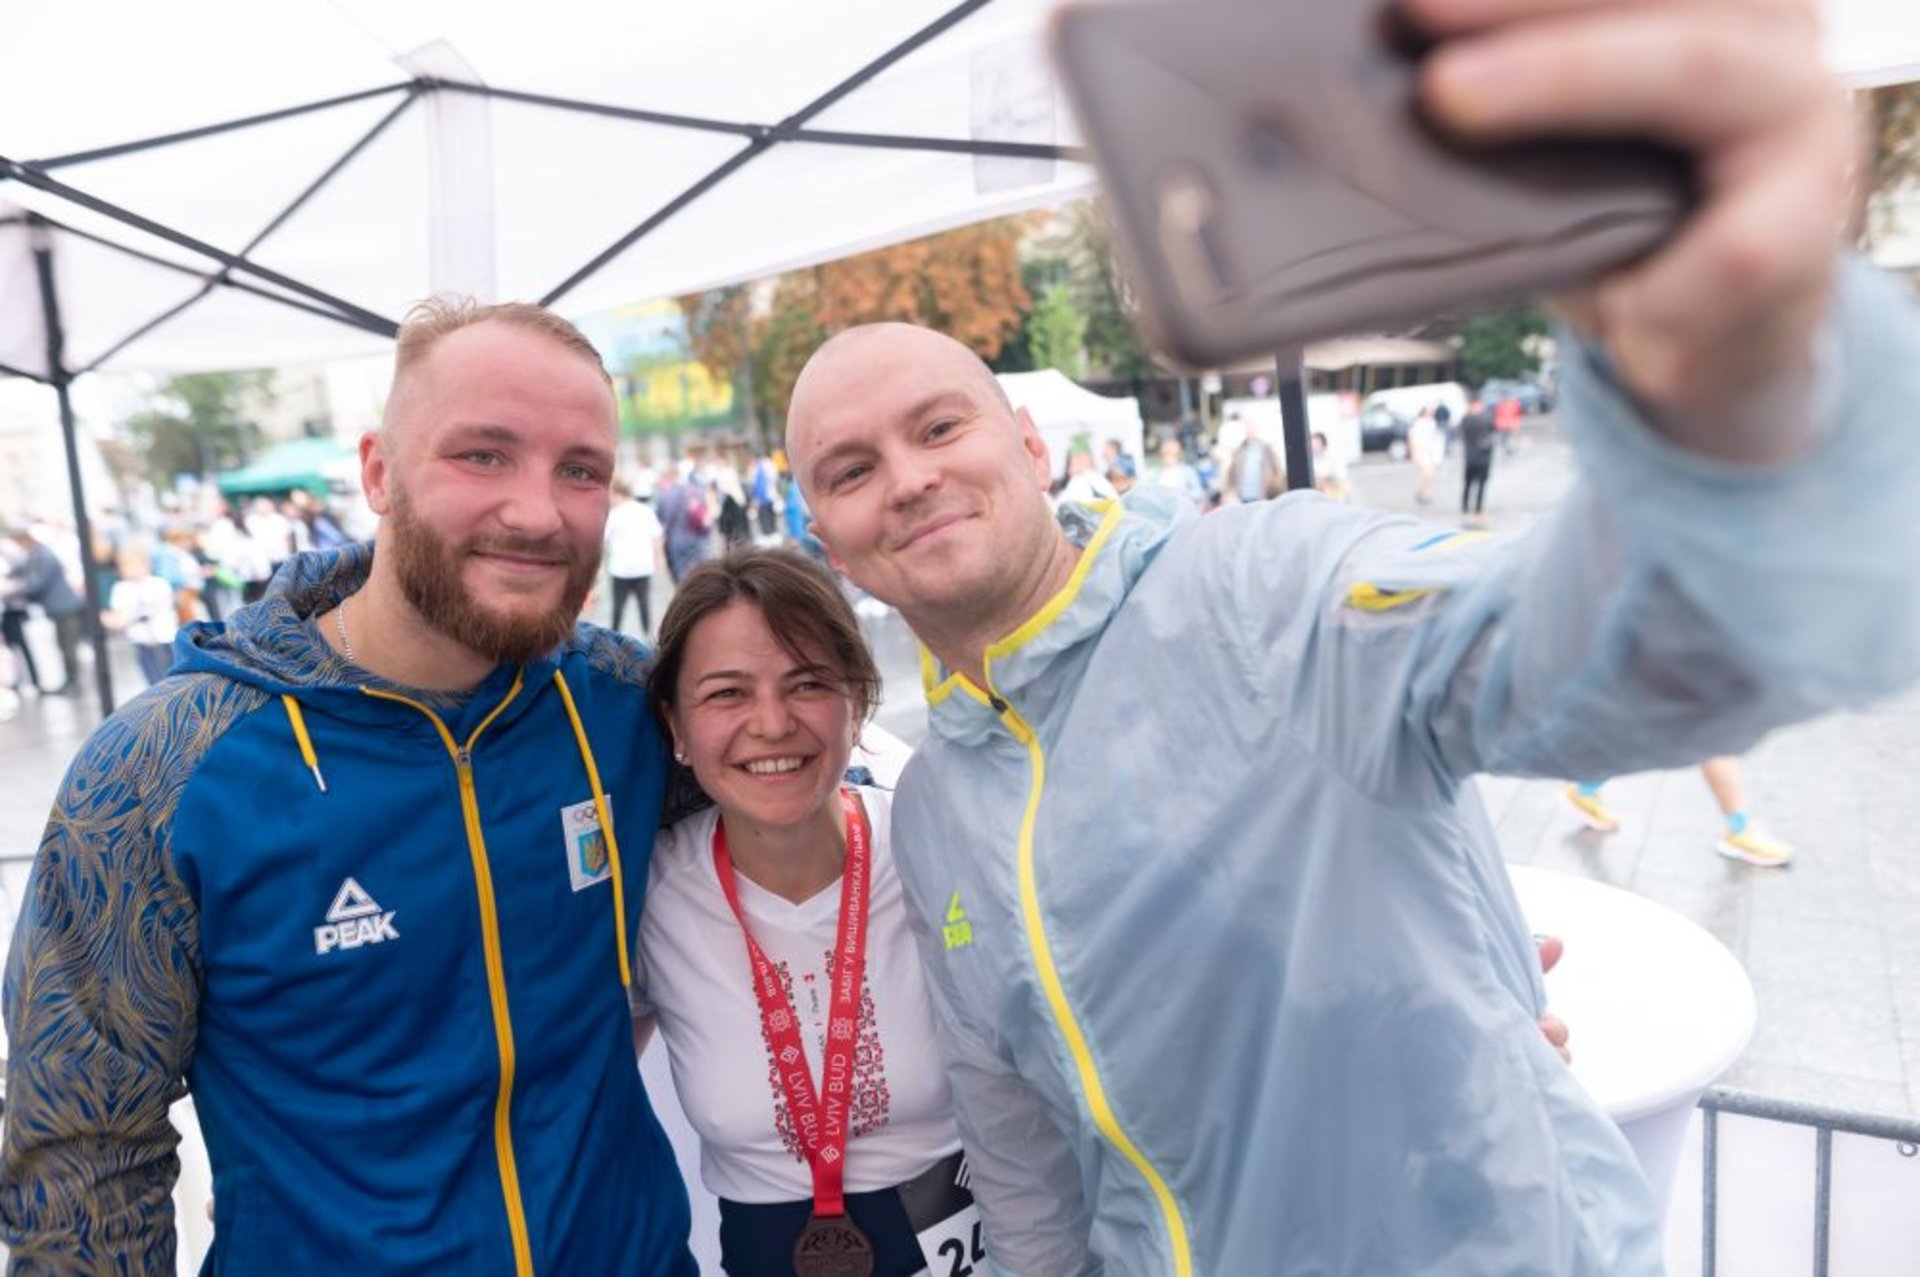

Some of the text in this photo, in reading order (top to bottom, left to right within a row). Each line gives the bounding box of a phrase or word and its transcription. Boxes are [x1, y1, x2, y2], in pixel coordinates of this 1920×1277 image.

[314, 910, 400, 955] PEAK
[788, 1071, 812, 1108] LVIV
[825, 1053, 846, 1137] LVIV BUD
